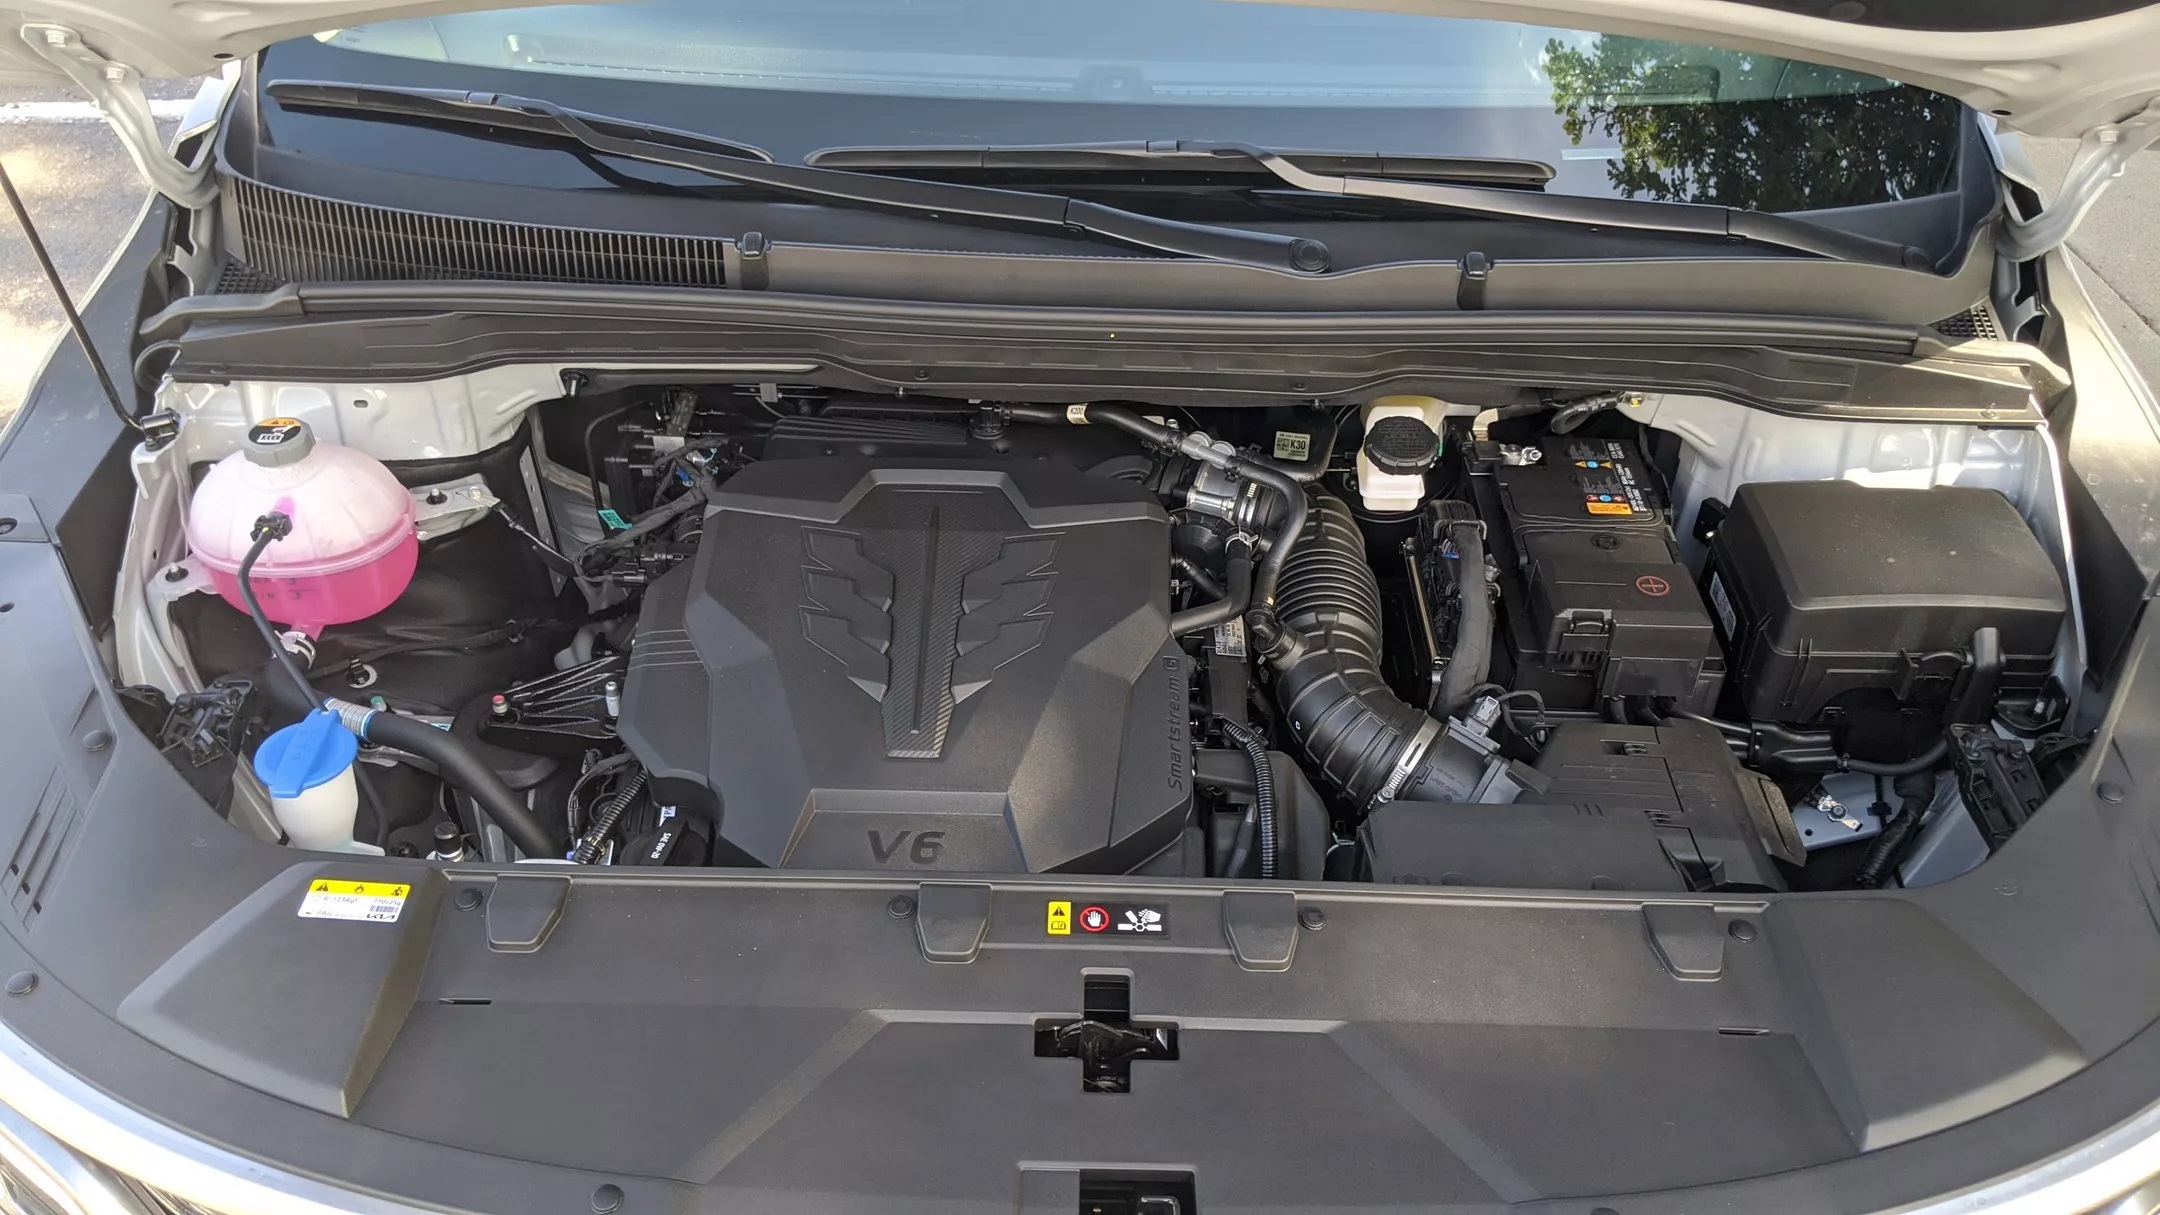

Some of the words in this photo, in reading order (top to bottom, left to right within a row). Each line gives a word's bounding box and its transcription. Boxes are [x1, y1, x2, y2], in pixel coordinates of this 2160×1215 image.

[1290, 439, 1306, 450] K30
[1168, 675, 1182, 792] Smartstream
[660, 832, 672, 842] SAE
[867, 830, 946, 865] V6
